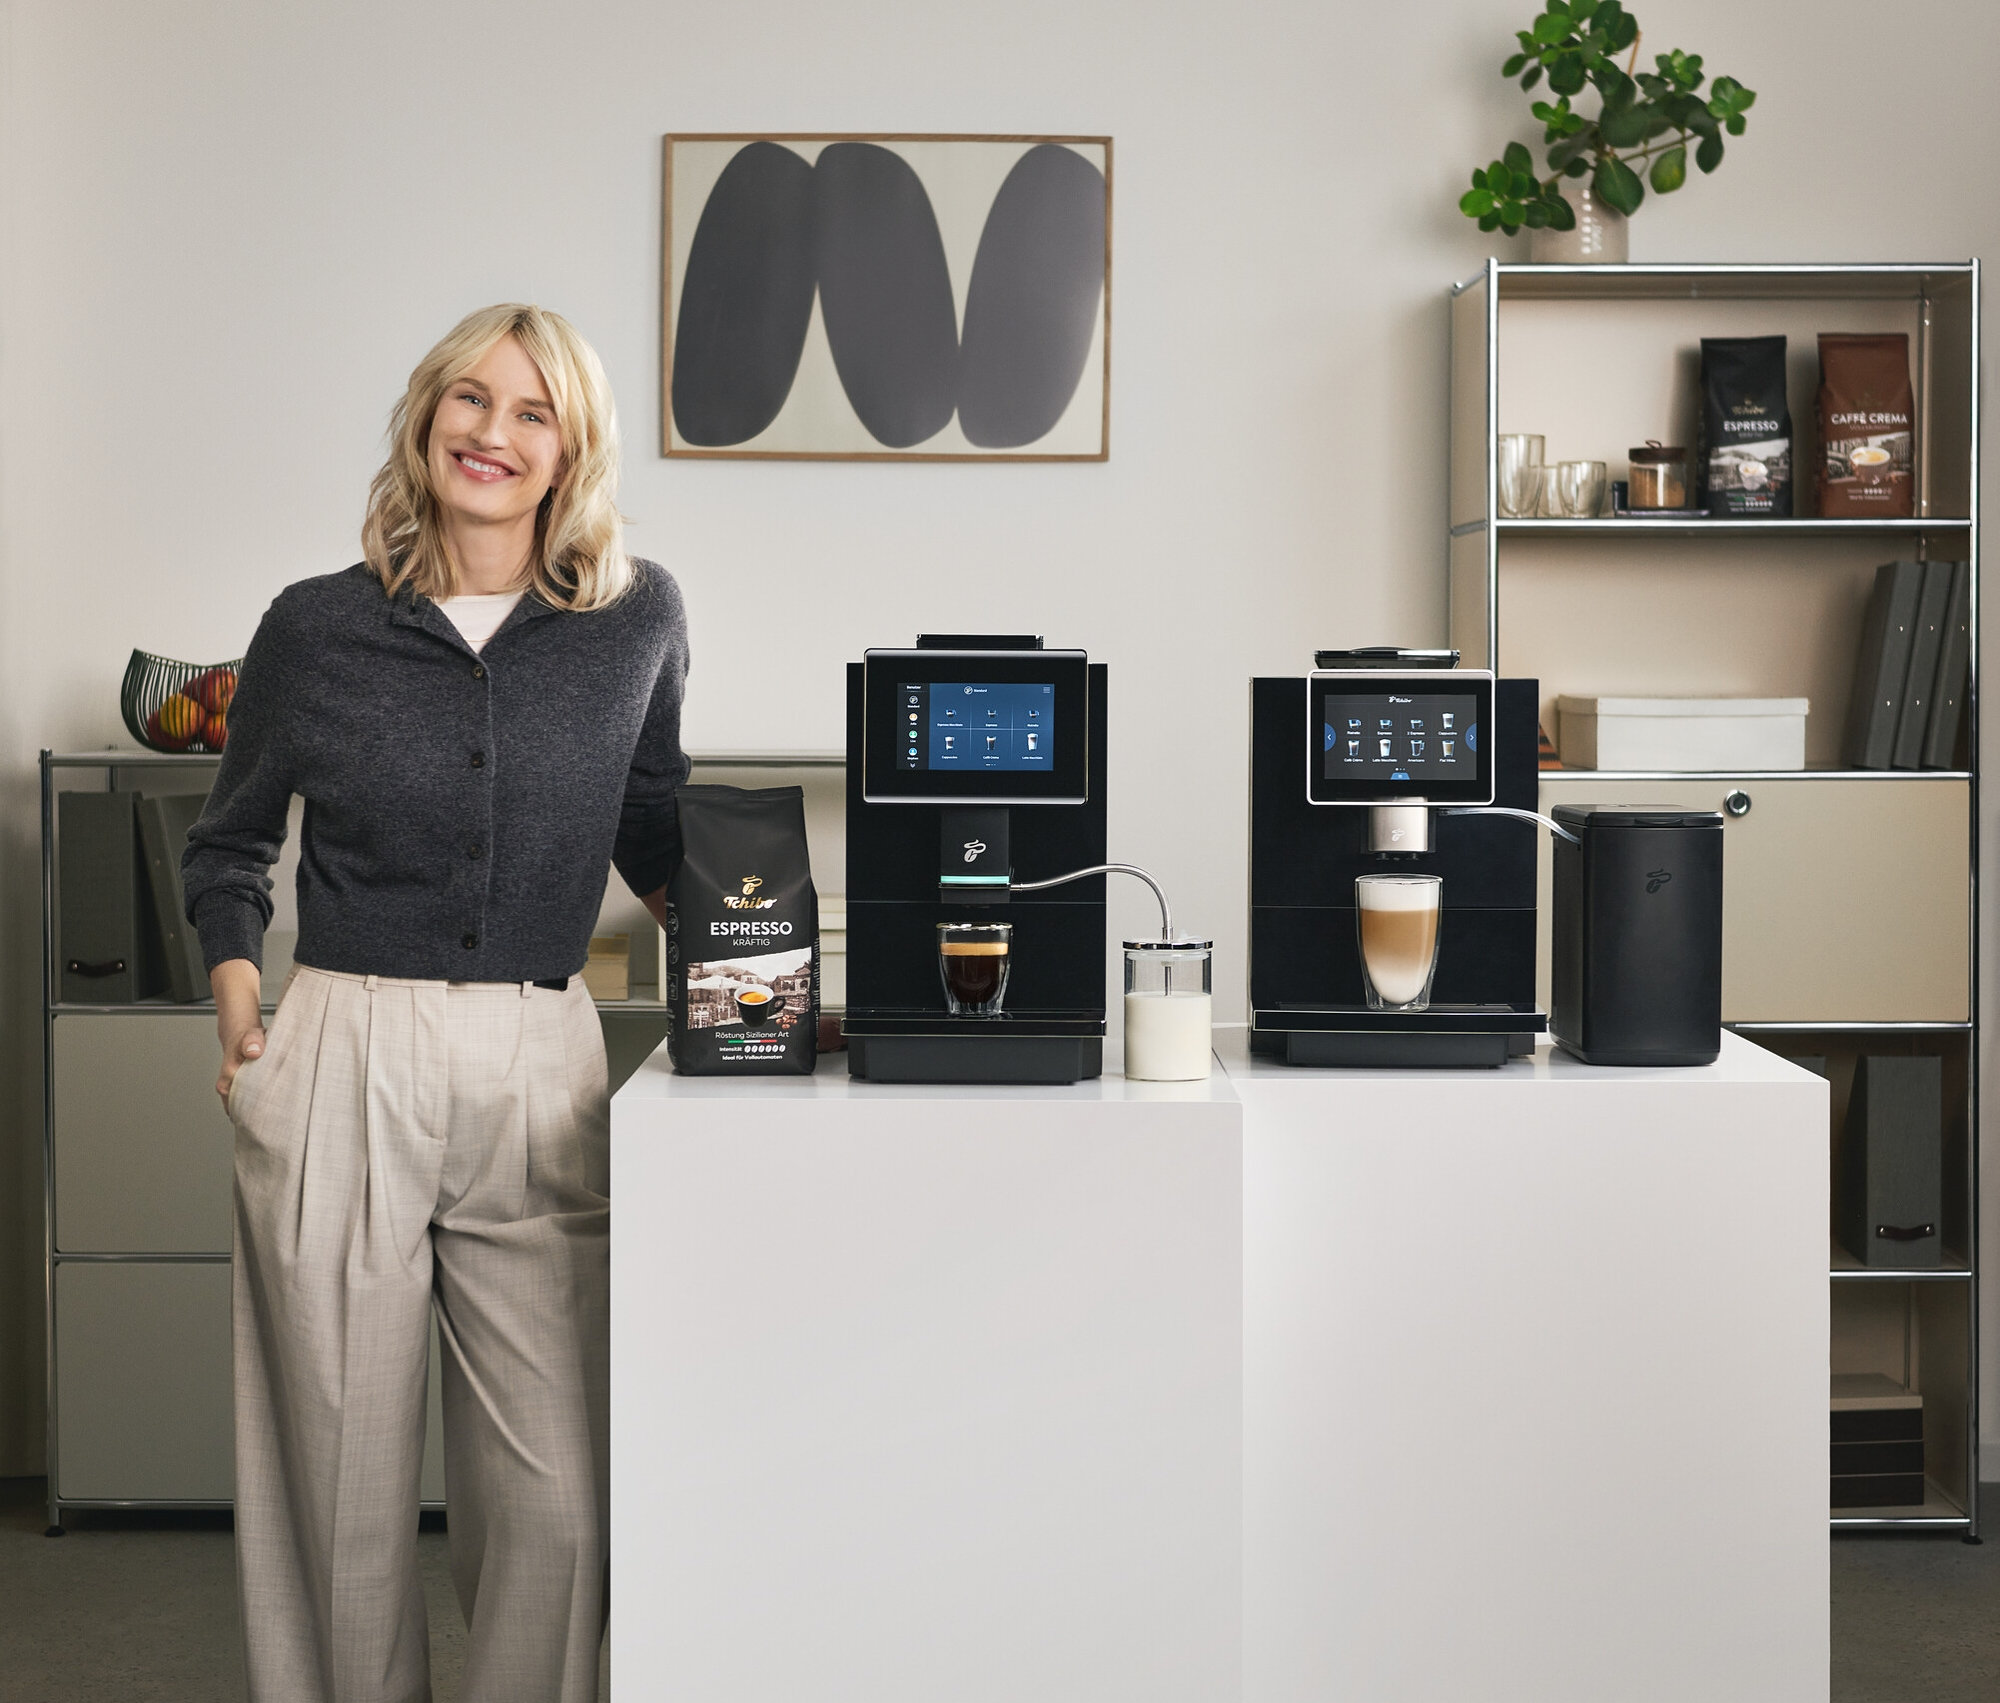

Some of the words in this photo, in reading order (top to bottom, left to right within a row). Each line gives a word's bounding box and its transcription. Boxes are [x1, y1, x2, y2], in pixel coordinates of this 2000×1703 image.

[1830, 410, 1867, 425] CAFFÈ
[1868, 412, 1908, 425] CREMA
[1723, 420, 1779, 432] ESPRESSO
[723, 896, 778, 909] Tchibo
[710, 921, 793, 936] ESPRESSO
[732, 937, 771, 946] KRÄFTIG
[715, 1031, 745, 1040] Röstung
[745, 1031, 777, 1039] Sizilianer
